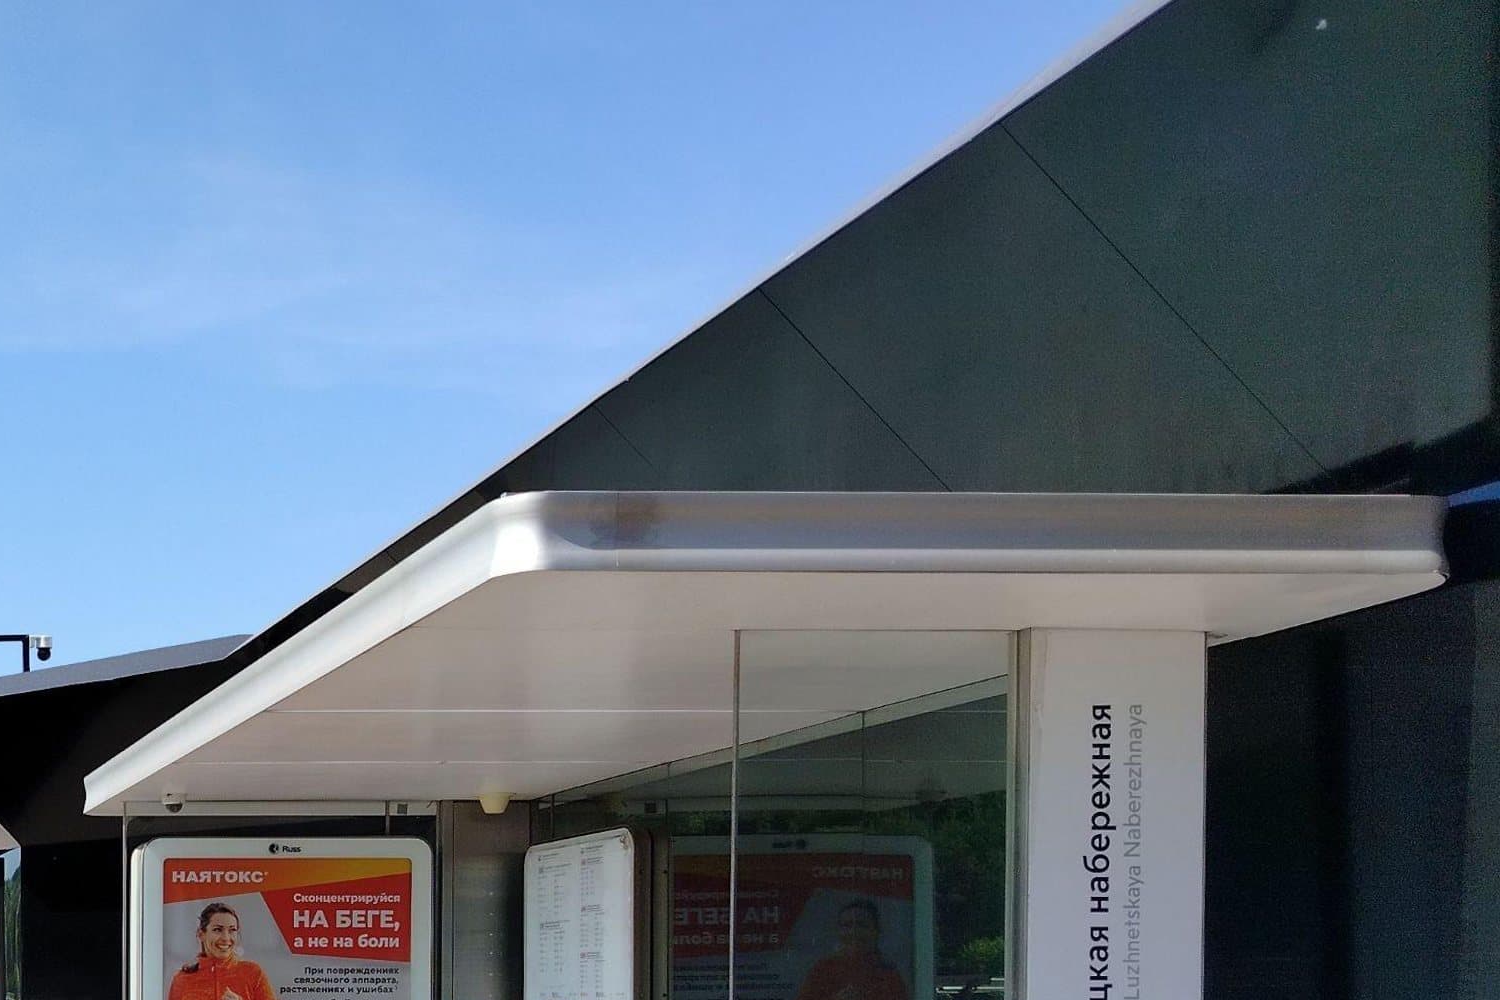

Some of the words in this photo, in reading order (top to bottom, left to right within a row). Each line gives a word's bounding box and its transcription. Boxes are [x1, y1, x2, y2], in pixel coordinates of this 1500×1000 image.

[1124, 703, 1148, 858] Naberezhnaya
[1082, 704, 1117, 913] набережная
[282, 845, 302, 853] Russ
[293, 893, 401, 905] Сконцентрируйся
[293, 909, 329, 928] НА
[336, 909, 401, 932] БЕГЕ,
[1124, 864, 1145, 1000] Luzhnetskaya
[293, 937, 304, 948] а
[308, 937, 329, 948] не
[333, 937, 354, 948] на
[357, 934, 400, 948] боли
[304, 967, 324, 975] При
[326, 967, 400, 975] повреждениях
[352, 977, 399, 985] аппарата,
[280, 986, 346, 994] растяжениях
